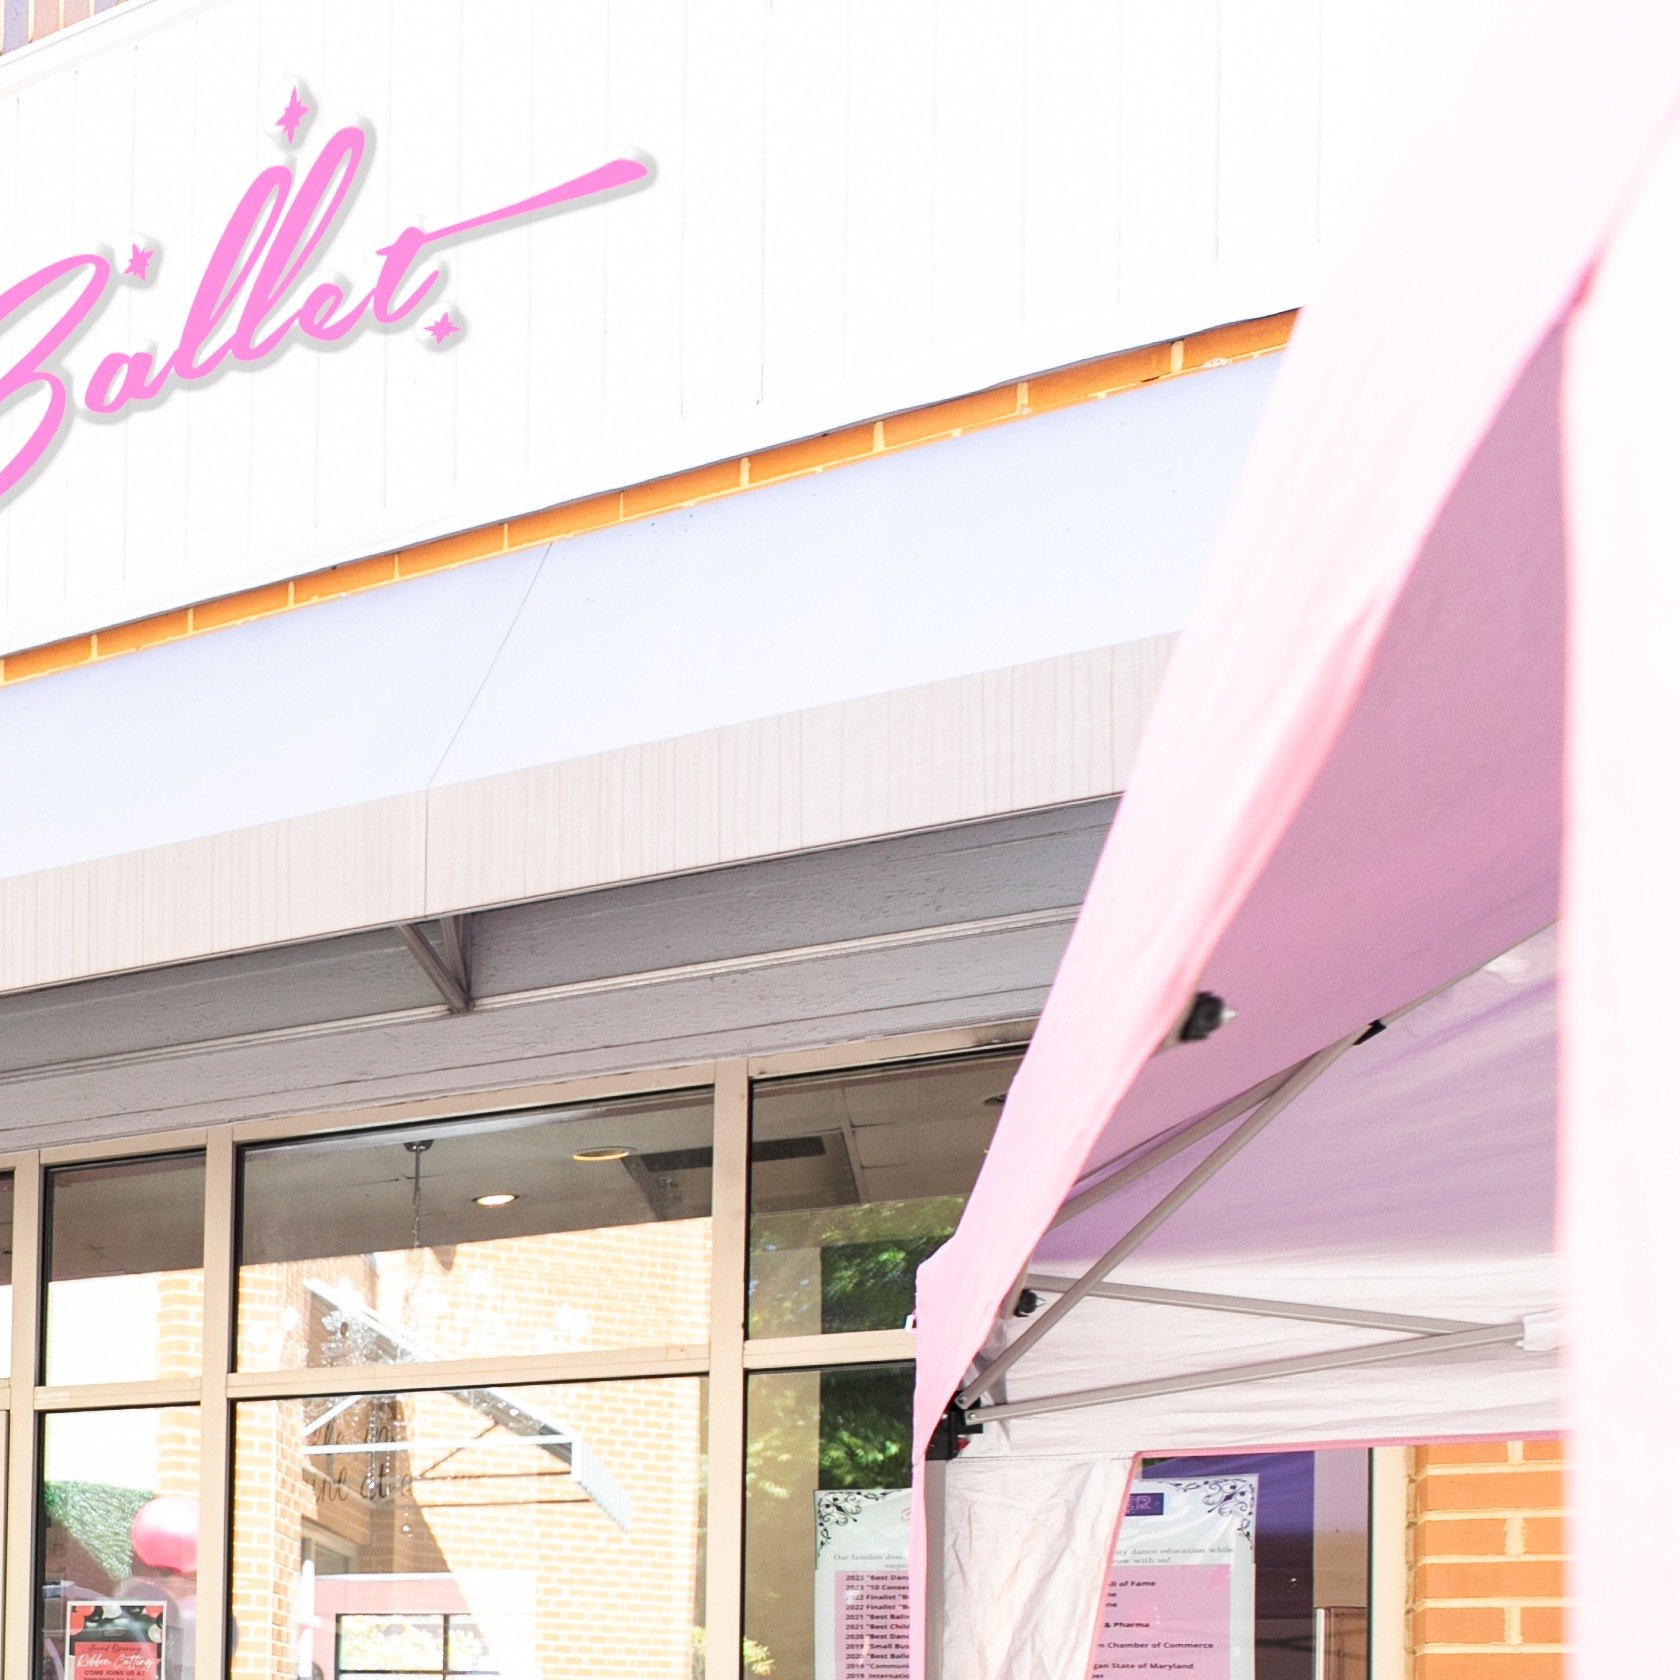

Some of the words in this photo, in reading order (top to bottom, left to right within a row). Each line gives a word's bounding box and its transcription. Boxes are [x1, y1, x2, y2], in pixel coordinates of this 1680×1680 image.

[1113, 1621, 1150, 1629] Pharma
[1107, 1641, 1150, 1649] Chamber
[1151, 1641, 1161, 1649] of
[1163, 1641, 1214, 1649] Commerce
[77, 1654, 112, 1668] Ribbon
[1112, 1662, 1136, 1670] State
[1150, 1662, 1194, 1671] Maryland
